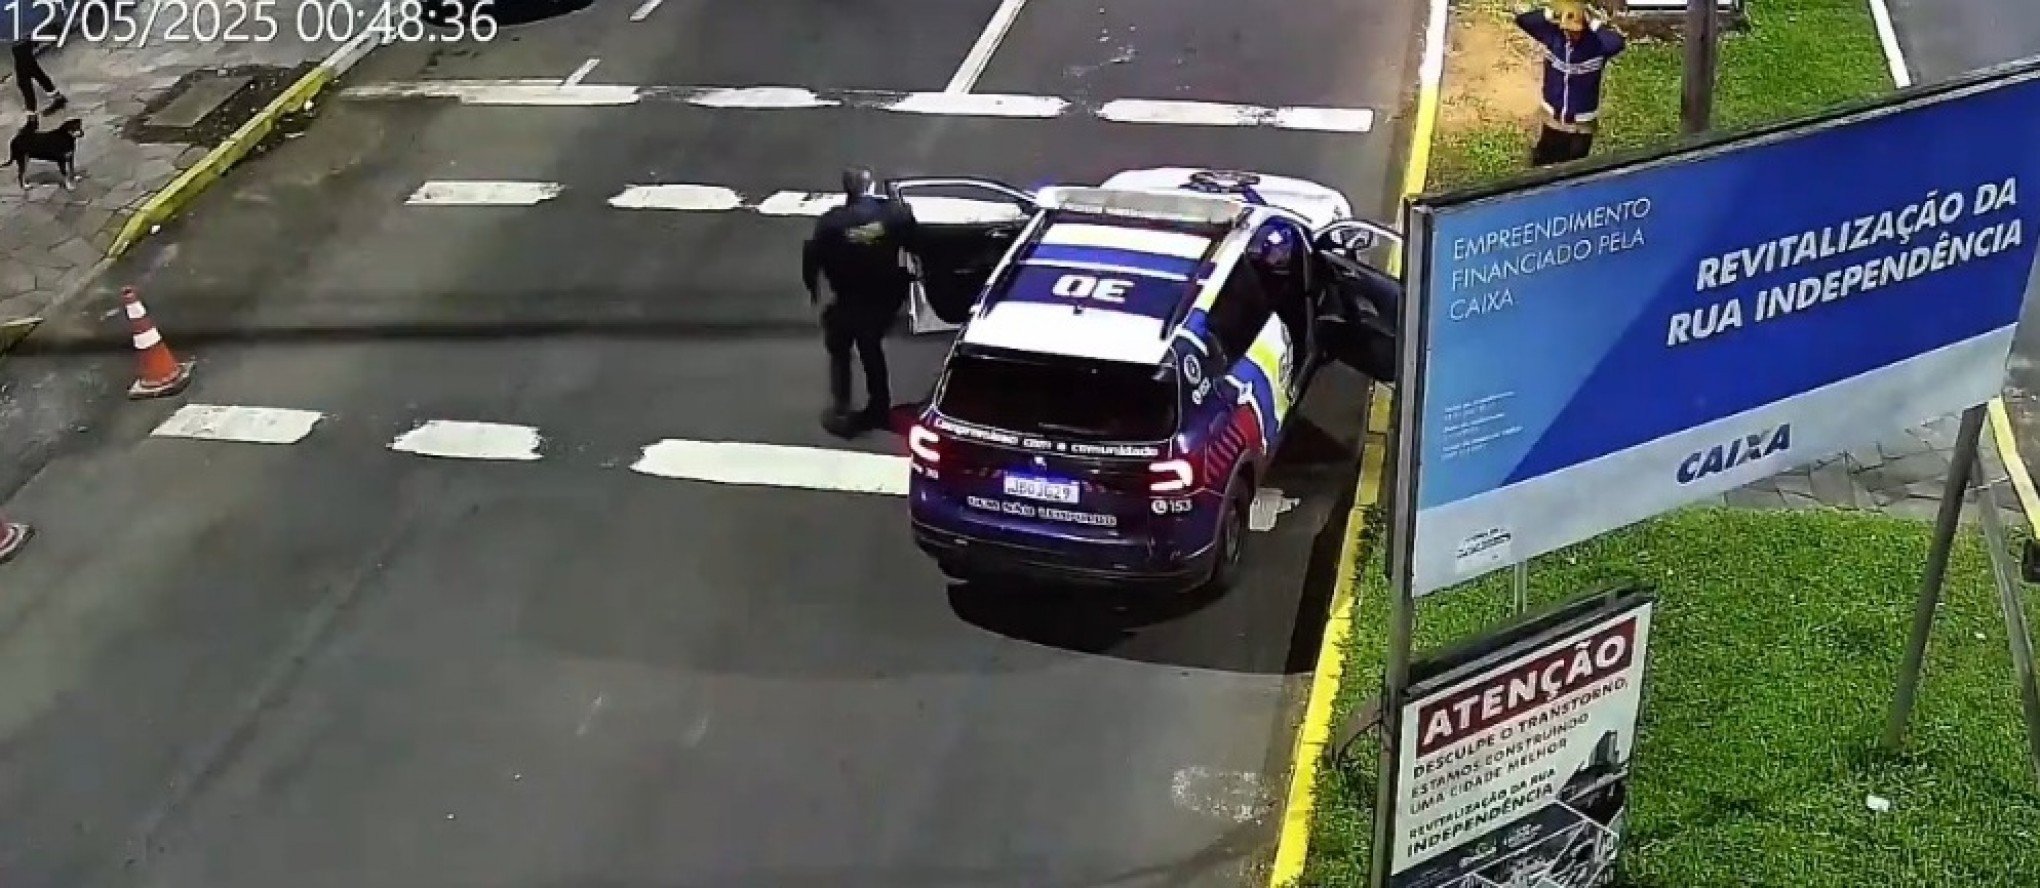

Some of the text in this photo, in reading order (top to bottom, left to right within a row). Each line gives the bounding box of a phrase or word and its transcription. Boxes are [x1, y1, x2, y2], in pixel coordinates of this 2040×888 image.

[1452, 227, 1645, 292] FINANCIADO PELA
[1454, 198, 1651, 260] EMPREENDIMENTO
[1696, 177, 2016, 292] REVITALIZAÇÃO DA
[1450, 288, 1514, 321] CAIXA
[1667, 219, 2022, 347] RUA INDEPENDÊNCIA
[1676, 423, 1791, 485] CAIXA
[1422, 635, 1626, 746] ATENÇÃO
[1410, 738, 1568, 815] UMA CIDADE MELHOR
[1411, 713, 1590, 799] ESTAMOS CONSTRUINDO
[1413, 733, 1496, 780] DESCULPE
[1500, 727, 1514, 740] O
[1407, 783, 1553, 857] INDEPENDÊNCIA
